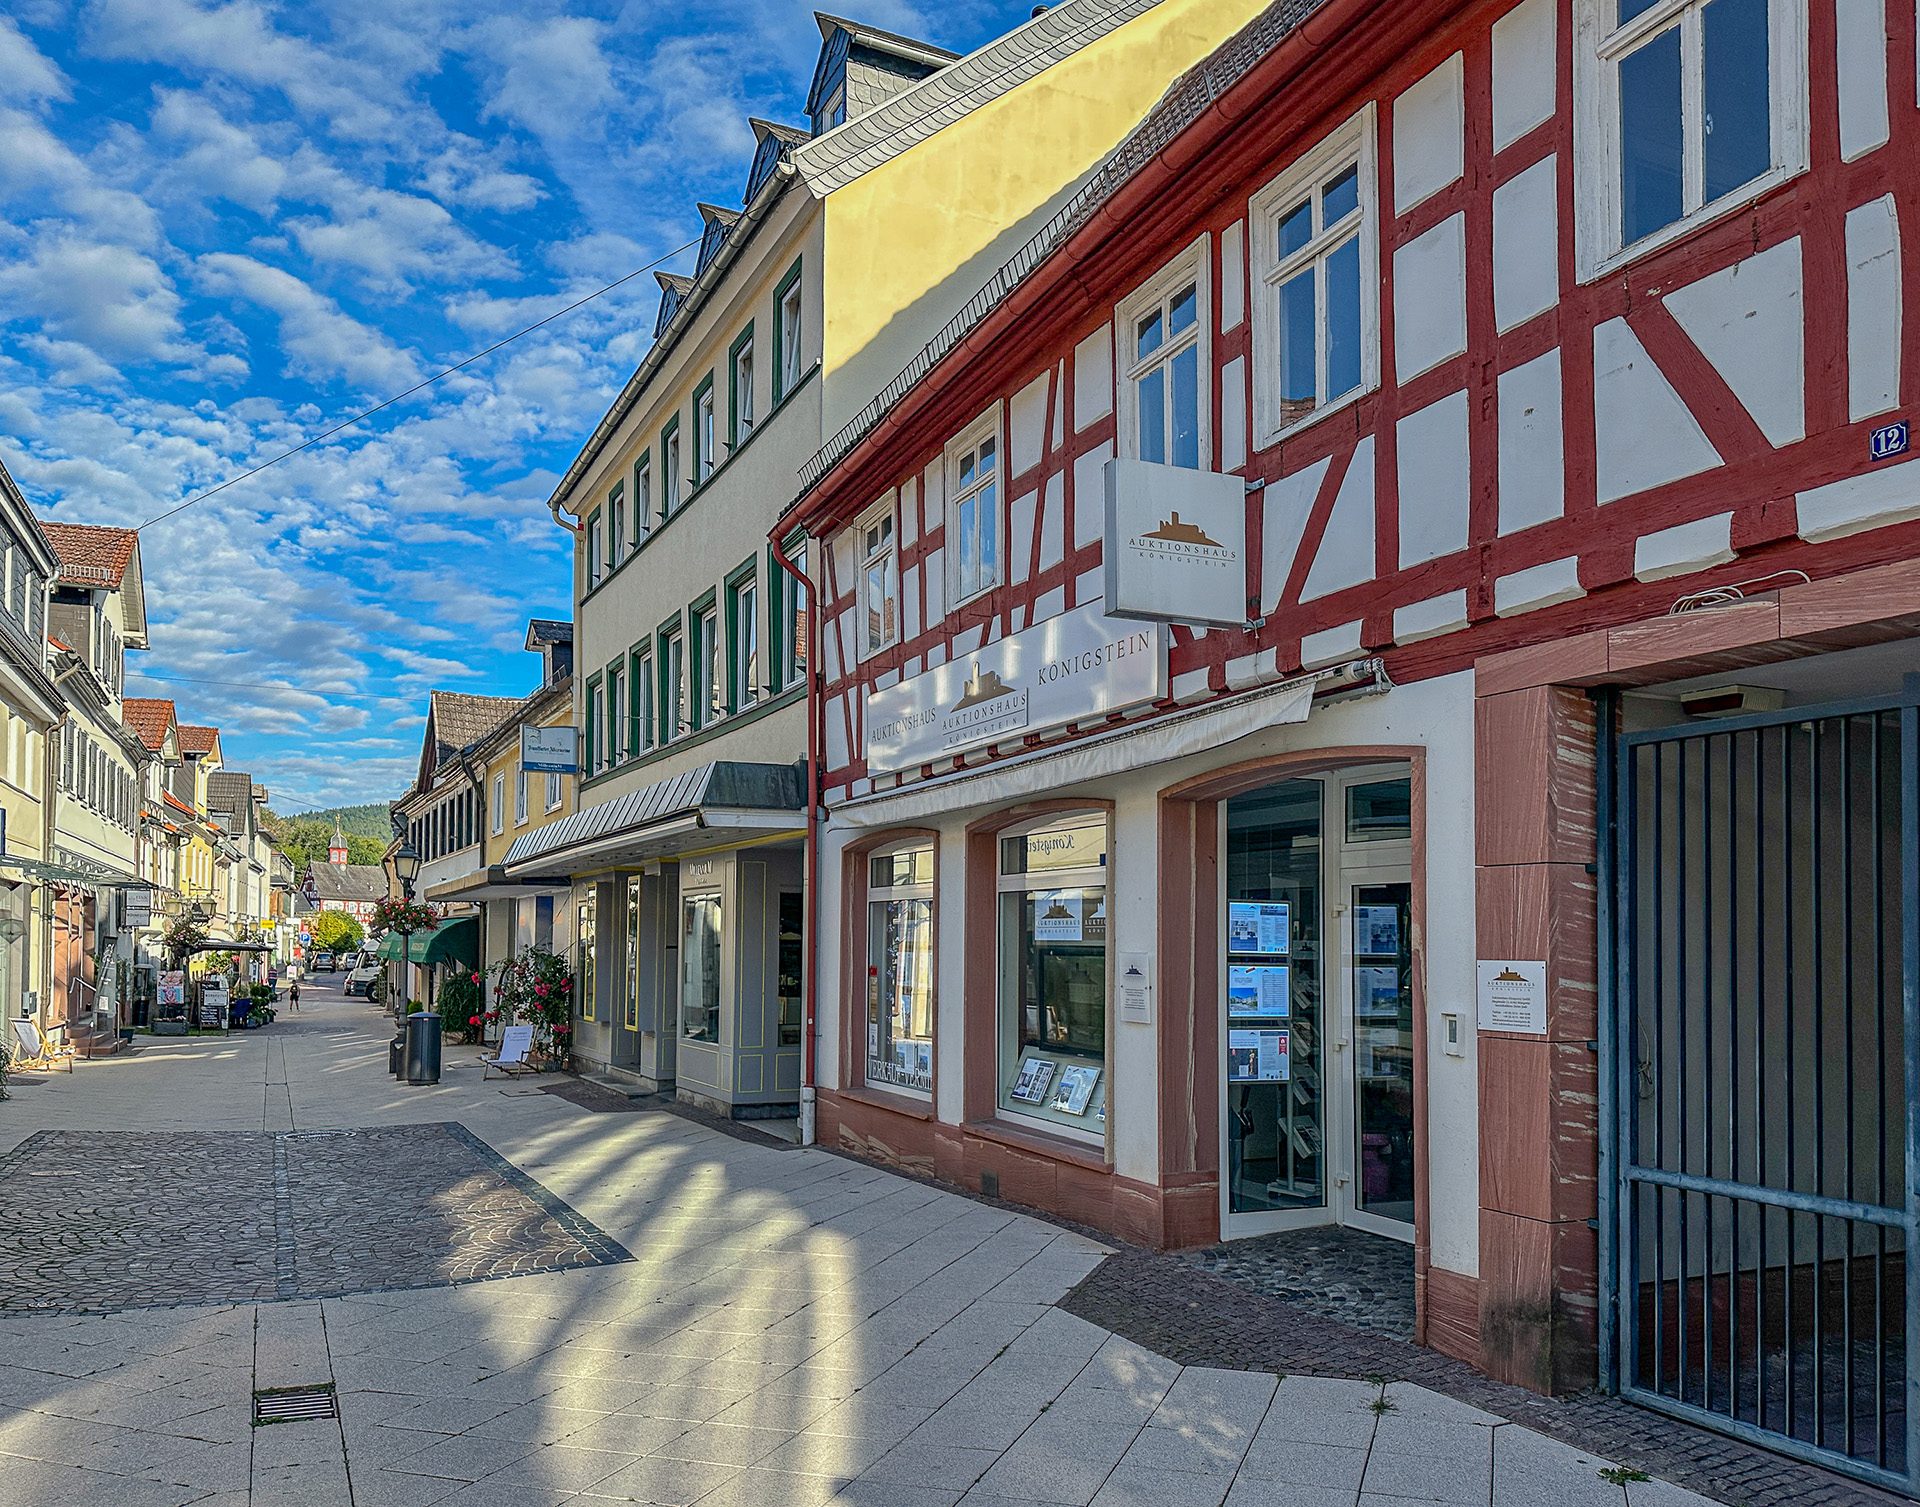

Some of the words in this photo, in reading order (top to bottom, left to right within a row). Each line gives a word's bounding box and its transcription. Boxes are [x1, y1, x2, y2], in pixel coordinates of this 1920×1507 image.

[1877, 428, 1900, 453] 12
[1128, 538, 1236, 559] AUKTIONSHAUS
[1139, 552, 1227, 568] KÖNIGSTEIN
[1036, 630, 1150, 686] KÖNIGSTEIN
[942, 693, 1027, 731] AUKTIONSHAUS
[870, 707, 937, 744] AUKTIONSHAUS
[949, 717, 1018, 744] KÖNIGSTEIN
[302, 934, 308, 942] P
